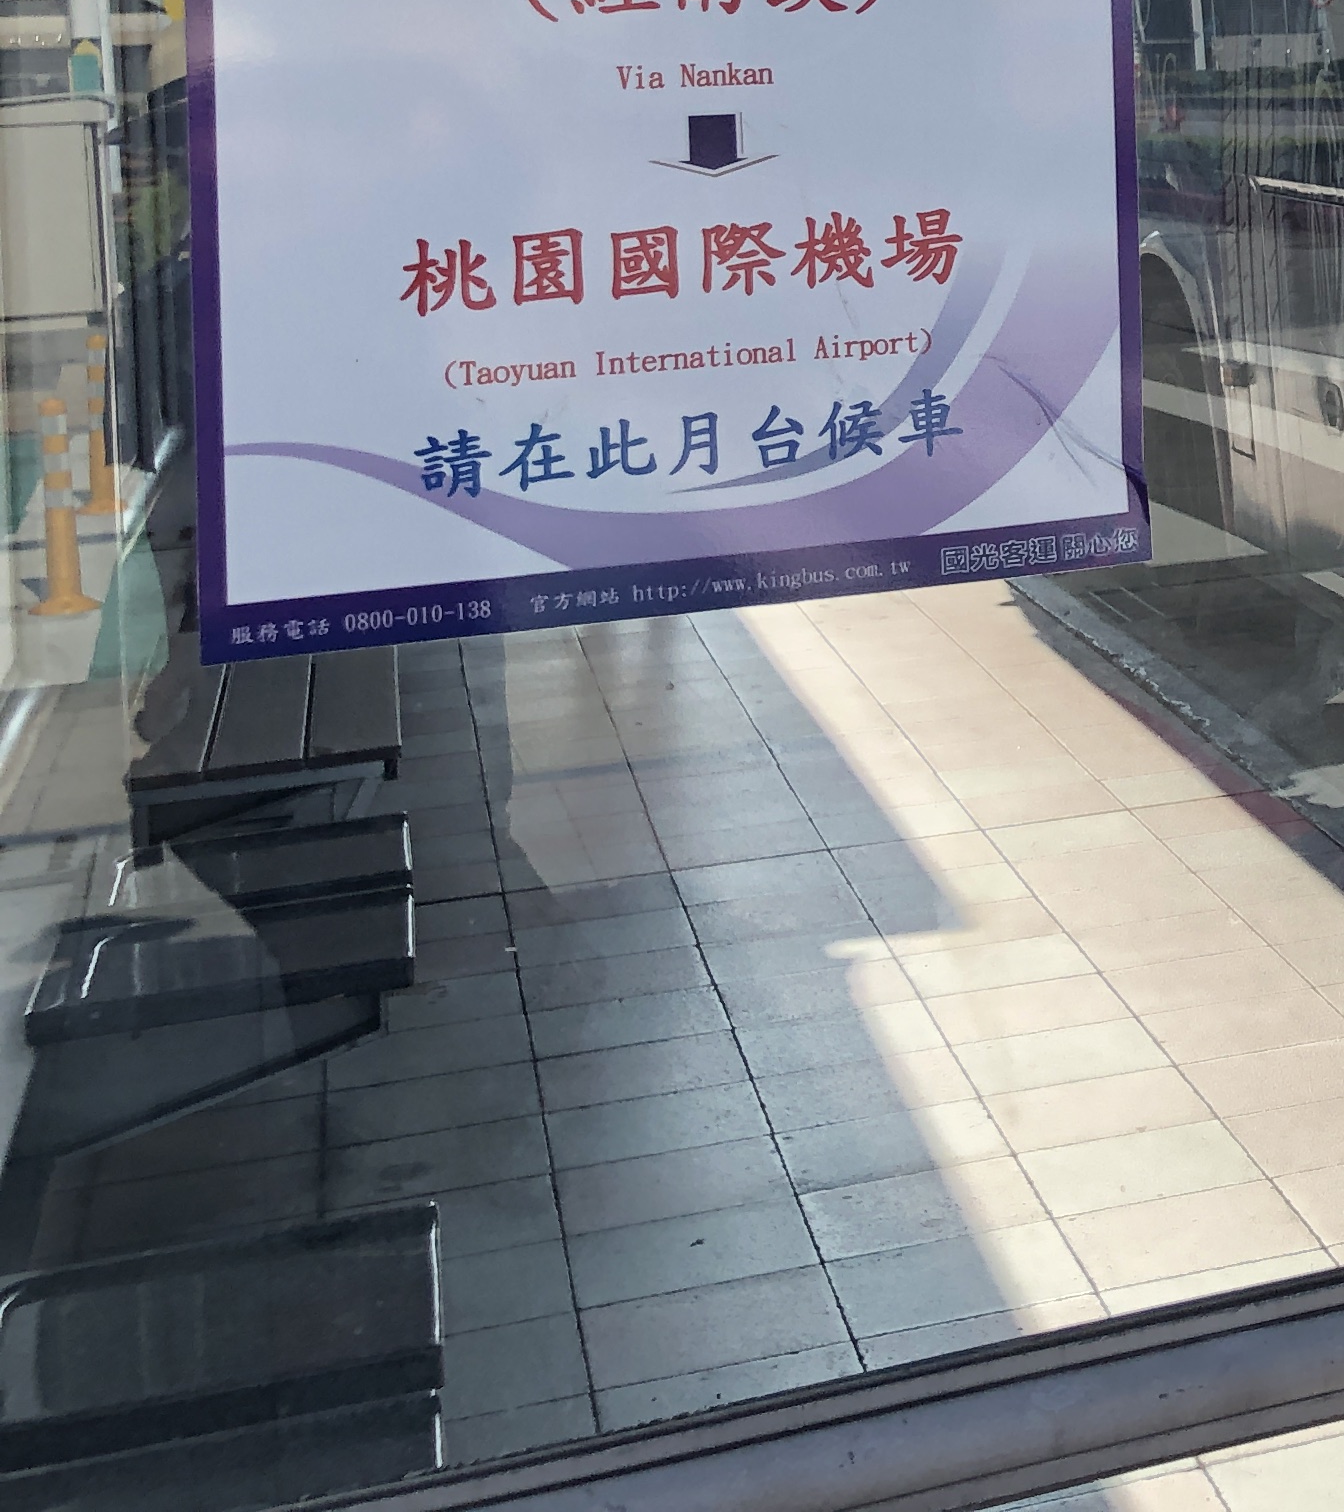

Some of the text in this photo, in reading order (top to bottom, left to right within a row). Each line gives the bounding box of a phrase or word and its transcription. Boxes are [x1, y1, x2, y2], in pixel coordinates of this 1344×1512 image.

[616, 62, 774, 90] Via Nankan
[400, 208, 964, 317] 桃園國際機場
[444, 326, 933, 390] (Taoyuan International Airport)
[413, 388, 964, 499] 請在此月台候車
[941, 527, 1140, 576] 國光客運 關心您
[529, 558, 912, 615] 官方網站 http://www.kingbus.com.tw
[230, 599, 493, 645] 服務電話 0800-010-138
